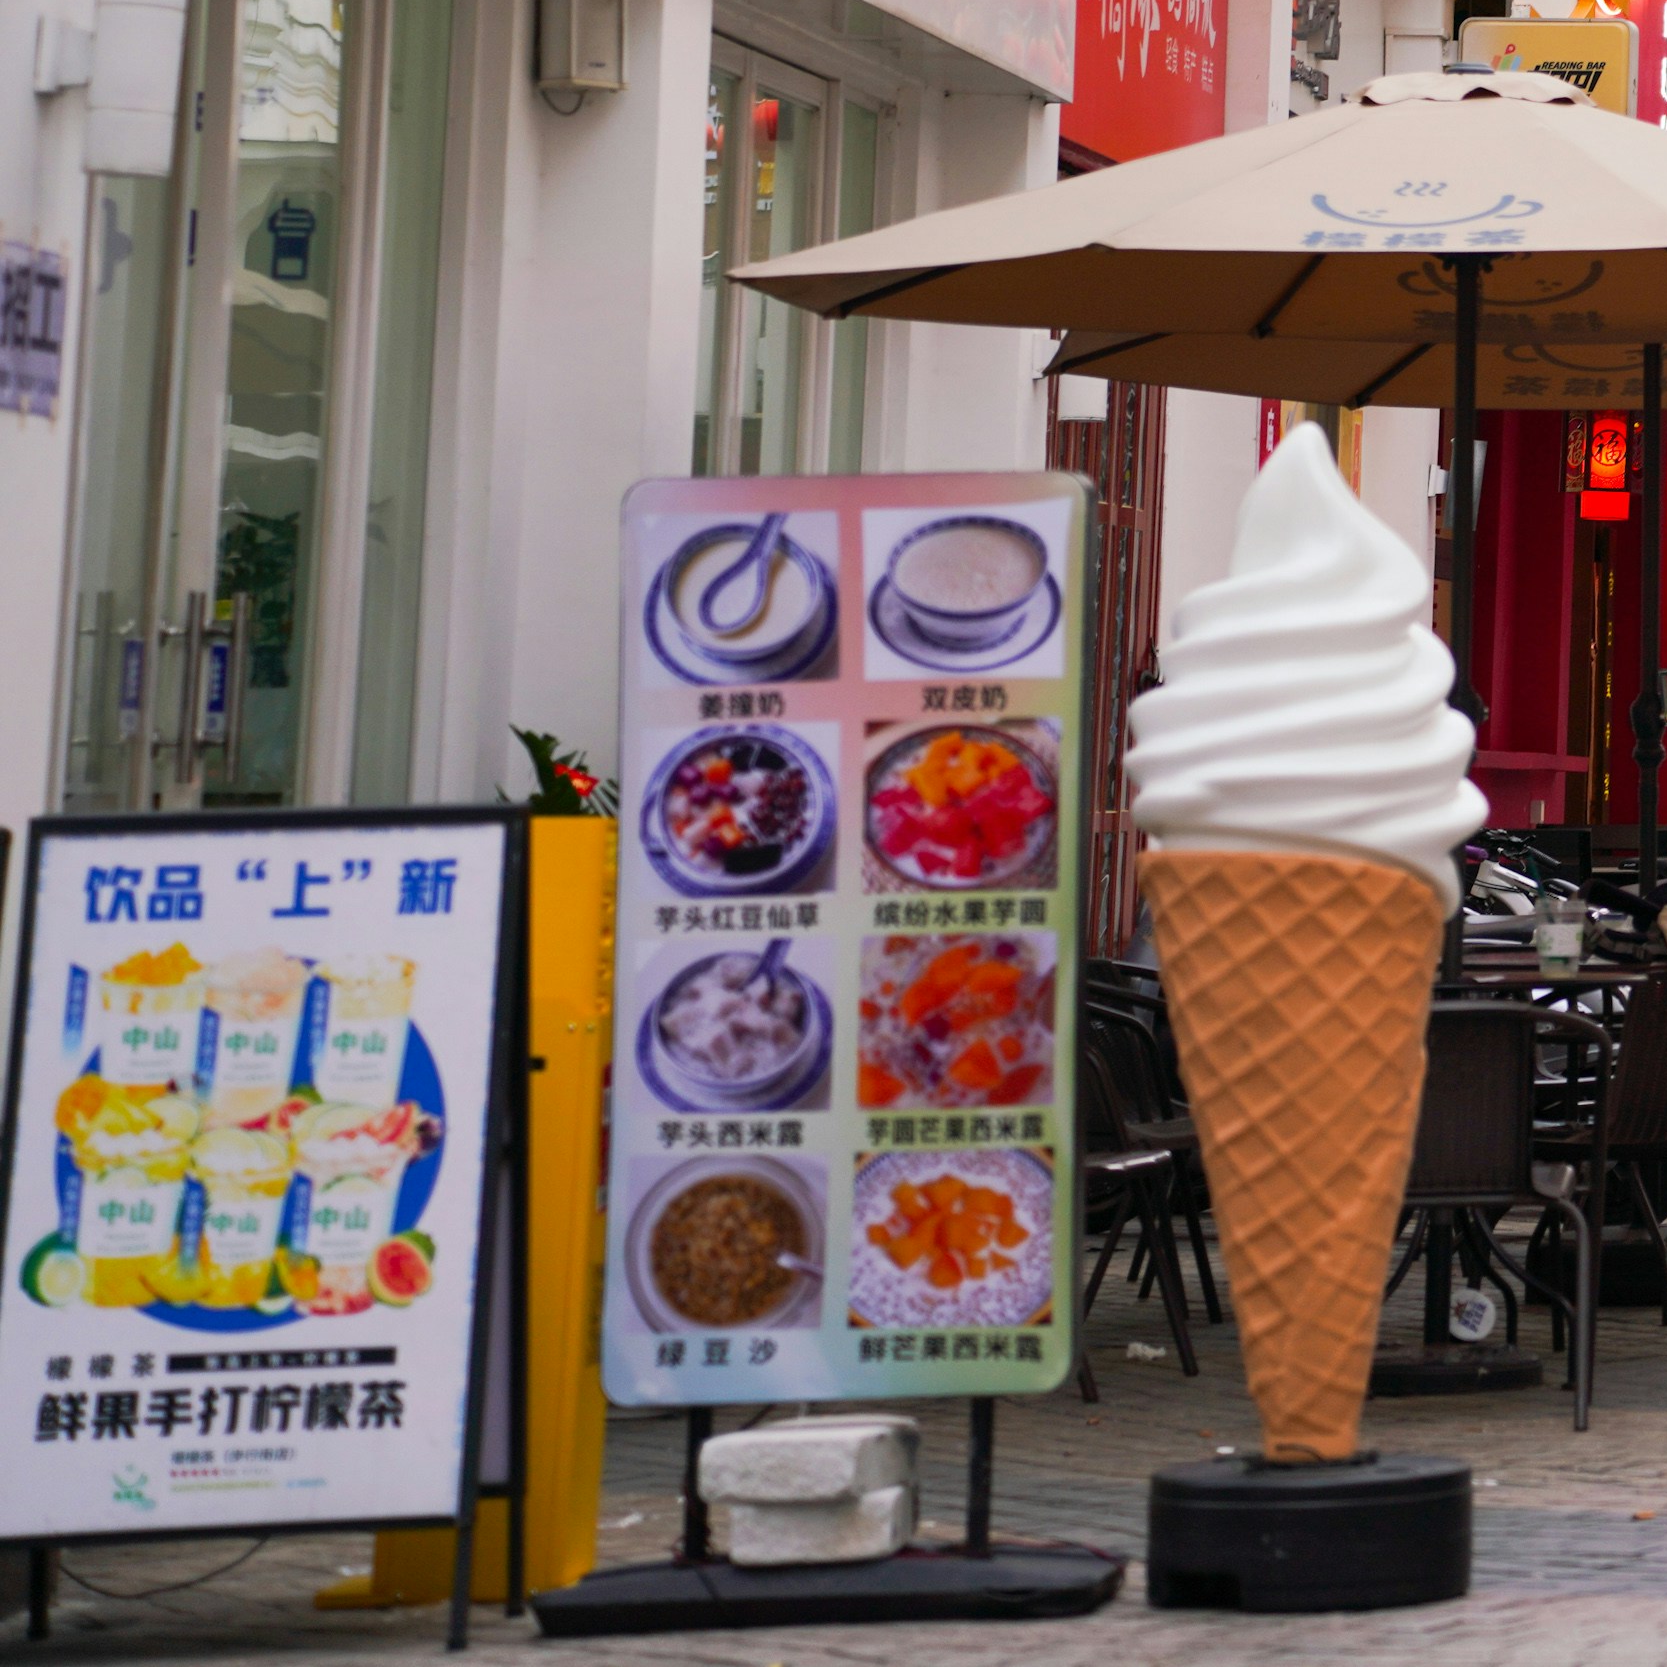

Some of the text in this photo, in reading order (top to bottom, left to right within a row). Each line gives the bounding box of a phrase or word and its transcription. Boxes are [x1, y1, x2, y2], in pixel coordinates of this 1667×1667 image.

[1541, 62, 1606, 70] READING BAR
[699, 693, 786, 719] 姜撞奶
[922, 685, 1008, 712] 双皮奶
[84, 865, 204, 924] 饮品
[397, 858, 458, 915] 新
[655, 902, 820, 931] 芋头红豆仙草
[873, 898, 1048, 927] 缤纷水果芋圆
[122, 1026, 180, 1052] 中山
[225, 1031, 278, 1055] 中山
[332, 1031, 387, 1055] 中山
[656, 1121, 804, 1148] 芋头西米露
[866, 1115, 1044, 1144] 芋圆芒果西米露
[98, 1198, 155, 1224] 中山
[209, 1213, 260, 1234] 中山
[313, 1206, 371, 1231] 中山
[656, 1339, 778, 1366] 绿豆沙
[859, 1336, 1044, 1363] 鲜芒果西米露
[35, 1381, 406, 1442] 鲜果手打柠檬茶
